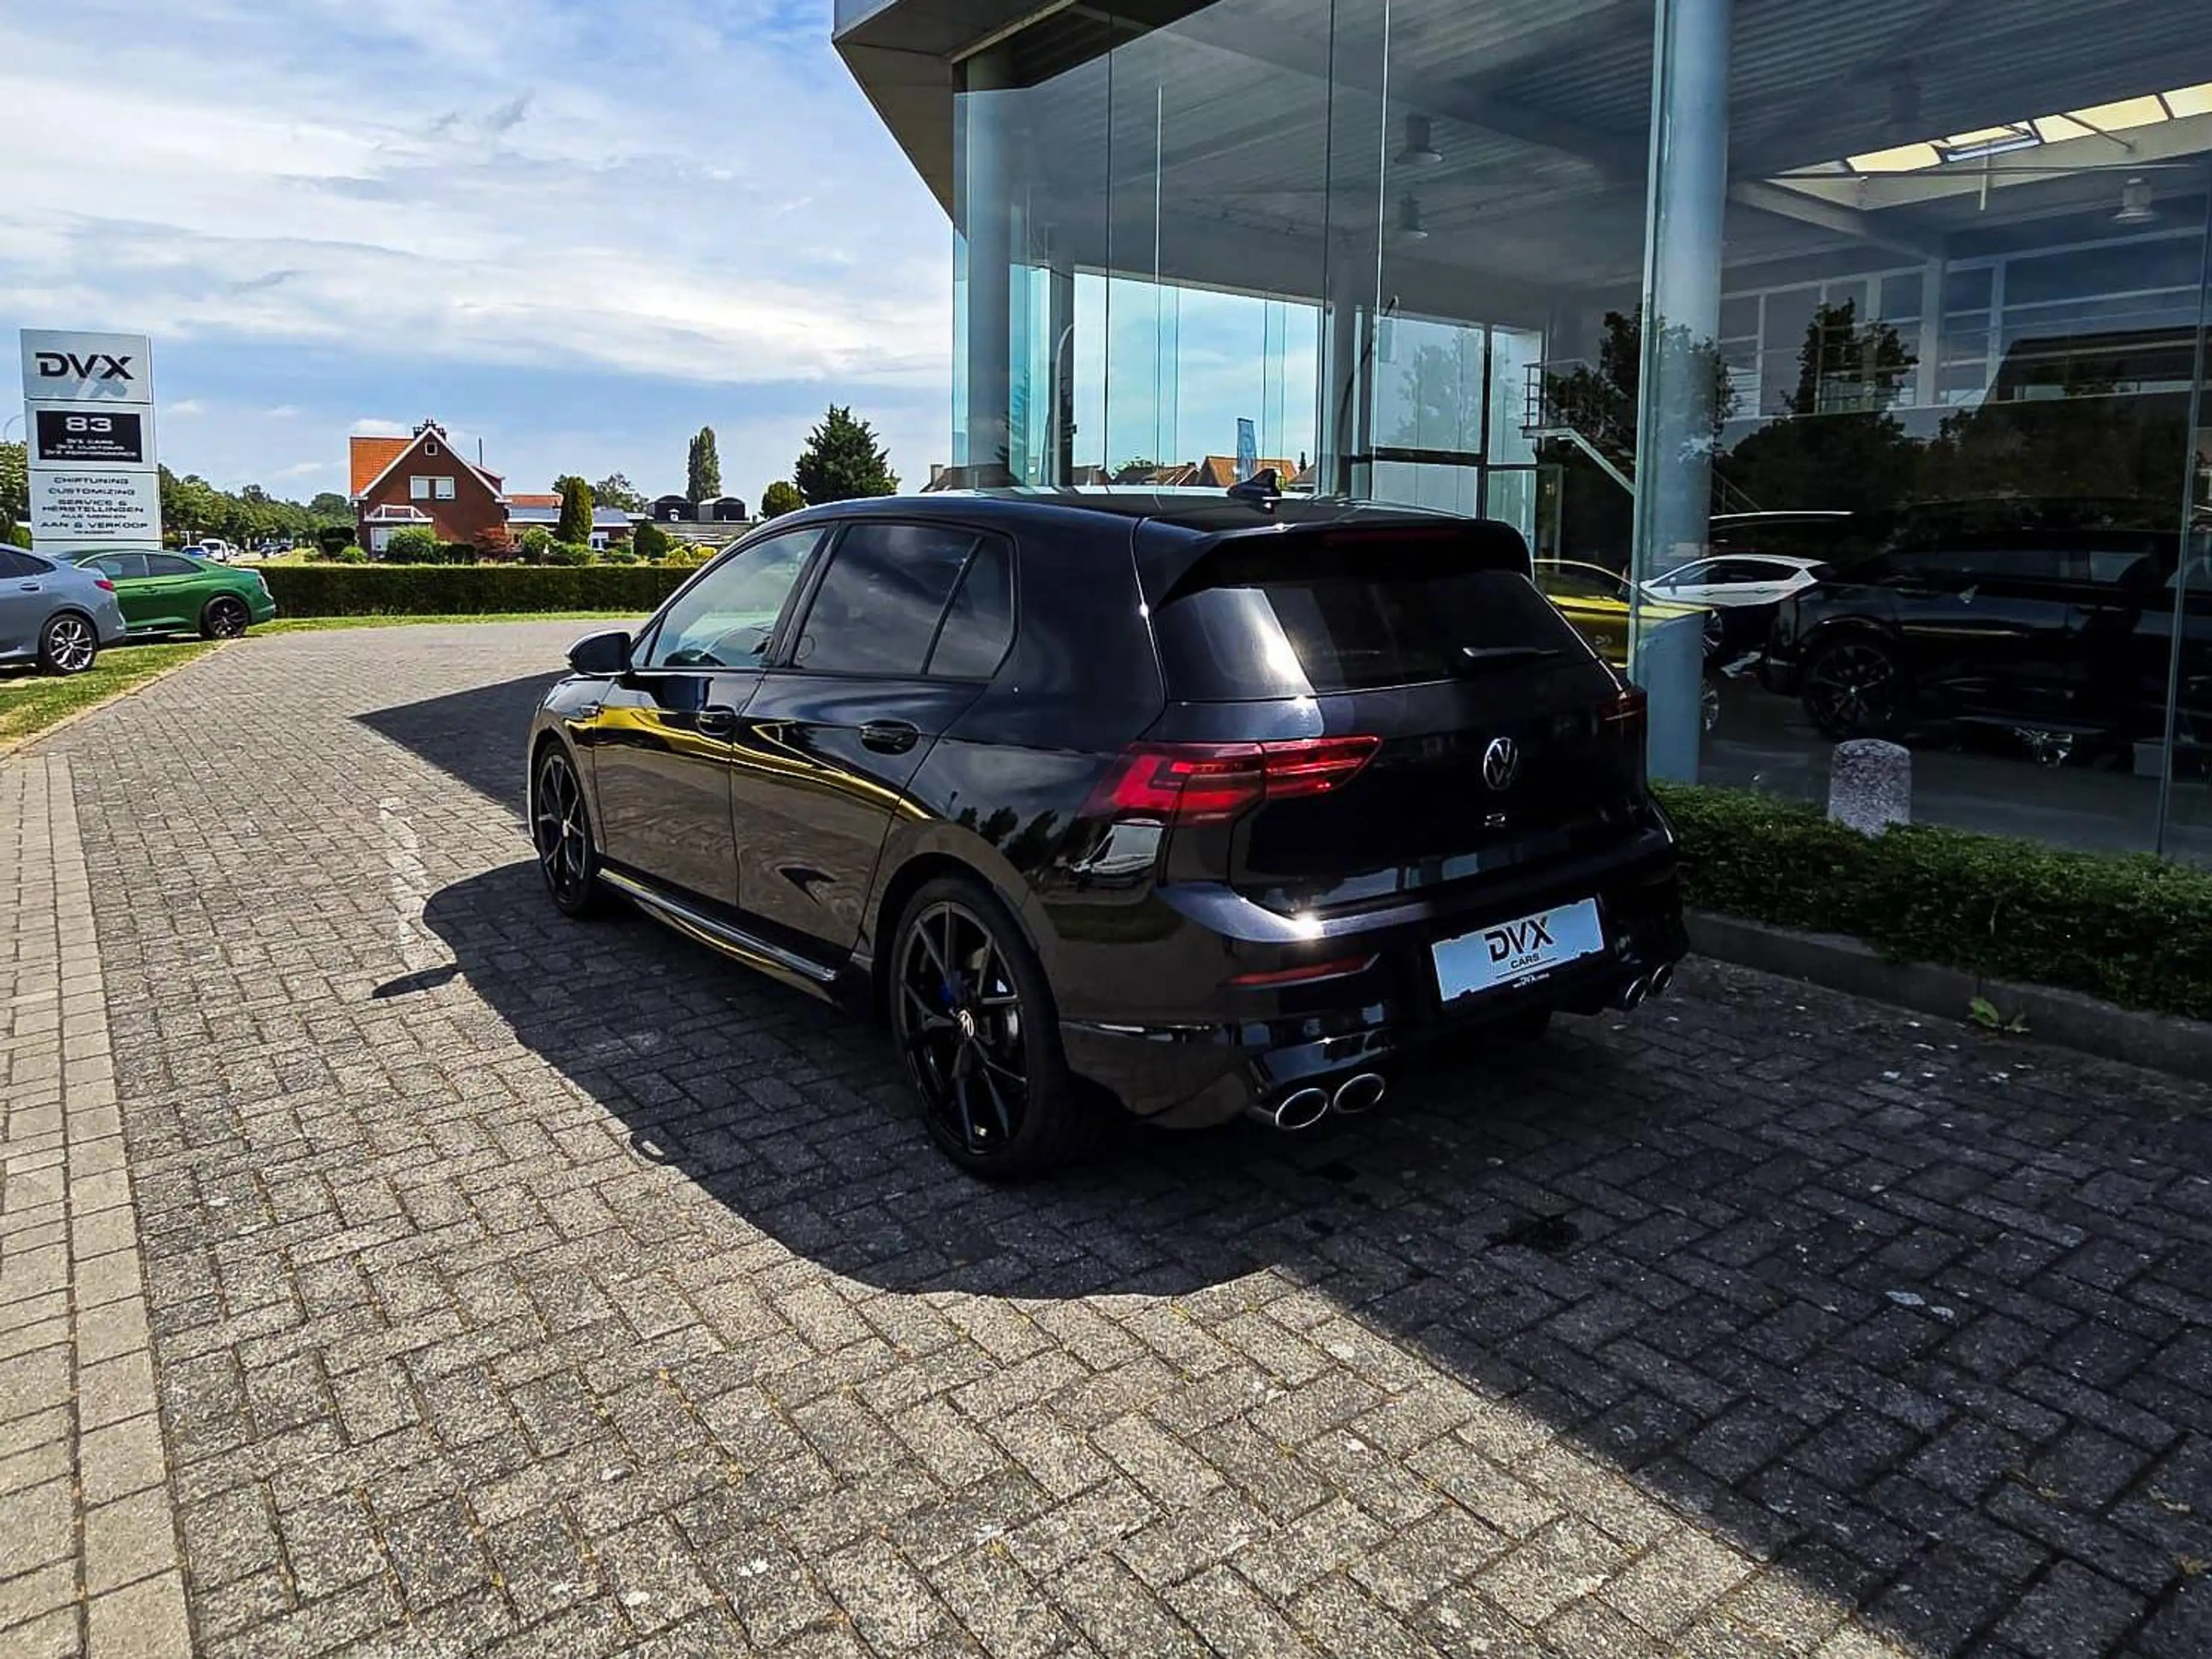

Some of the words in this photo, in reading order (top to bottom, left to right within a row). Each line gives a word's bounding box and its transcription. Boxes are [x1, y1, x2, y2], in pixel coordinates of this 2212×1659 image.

[36, 353, 135, 380] DVX
[66, 416, 112, 432] 83
[48, 487, 135, 495] CUSTOMIZING
[1484, 916, 1554, 962] DVX
[1510, 953, 1540, 969] CARS
